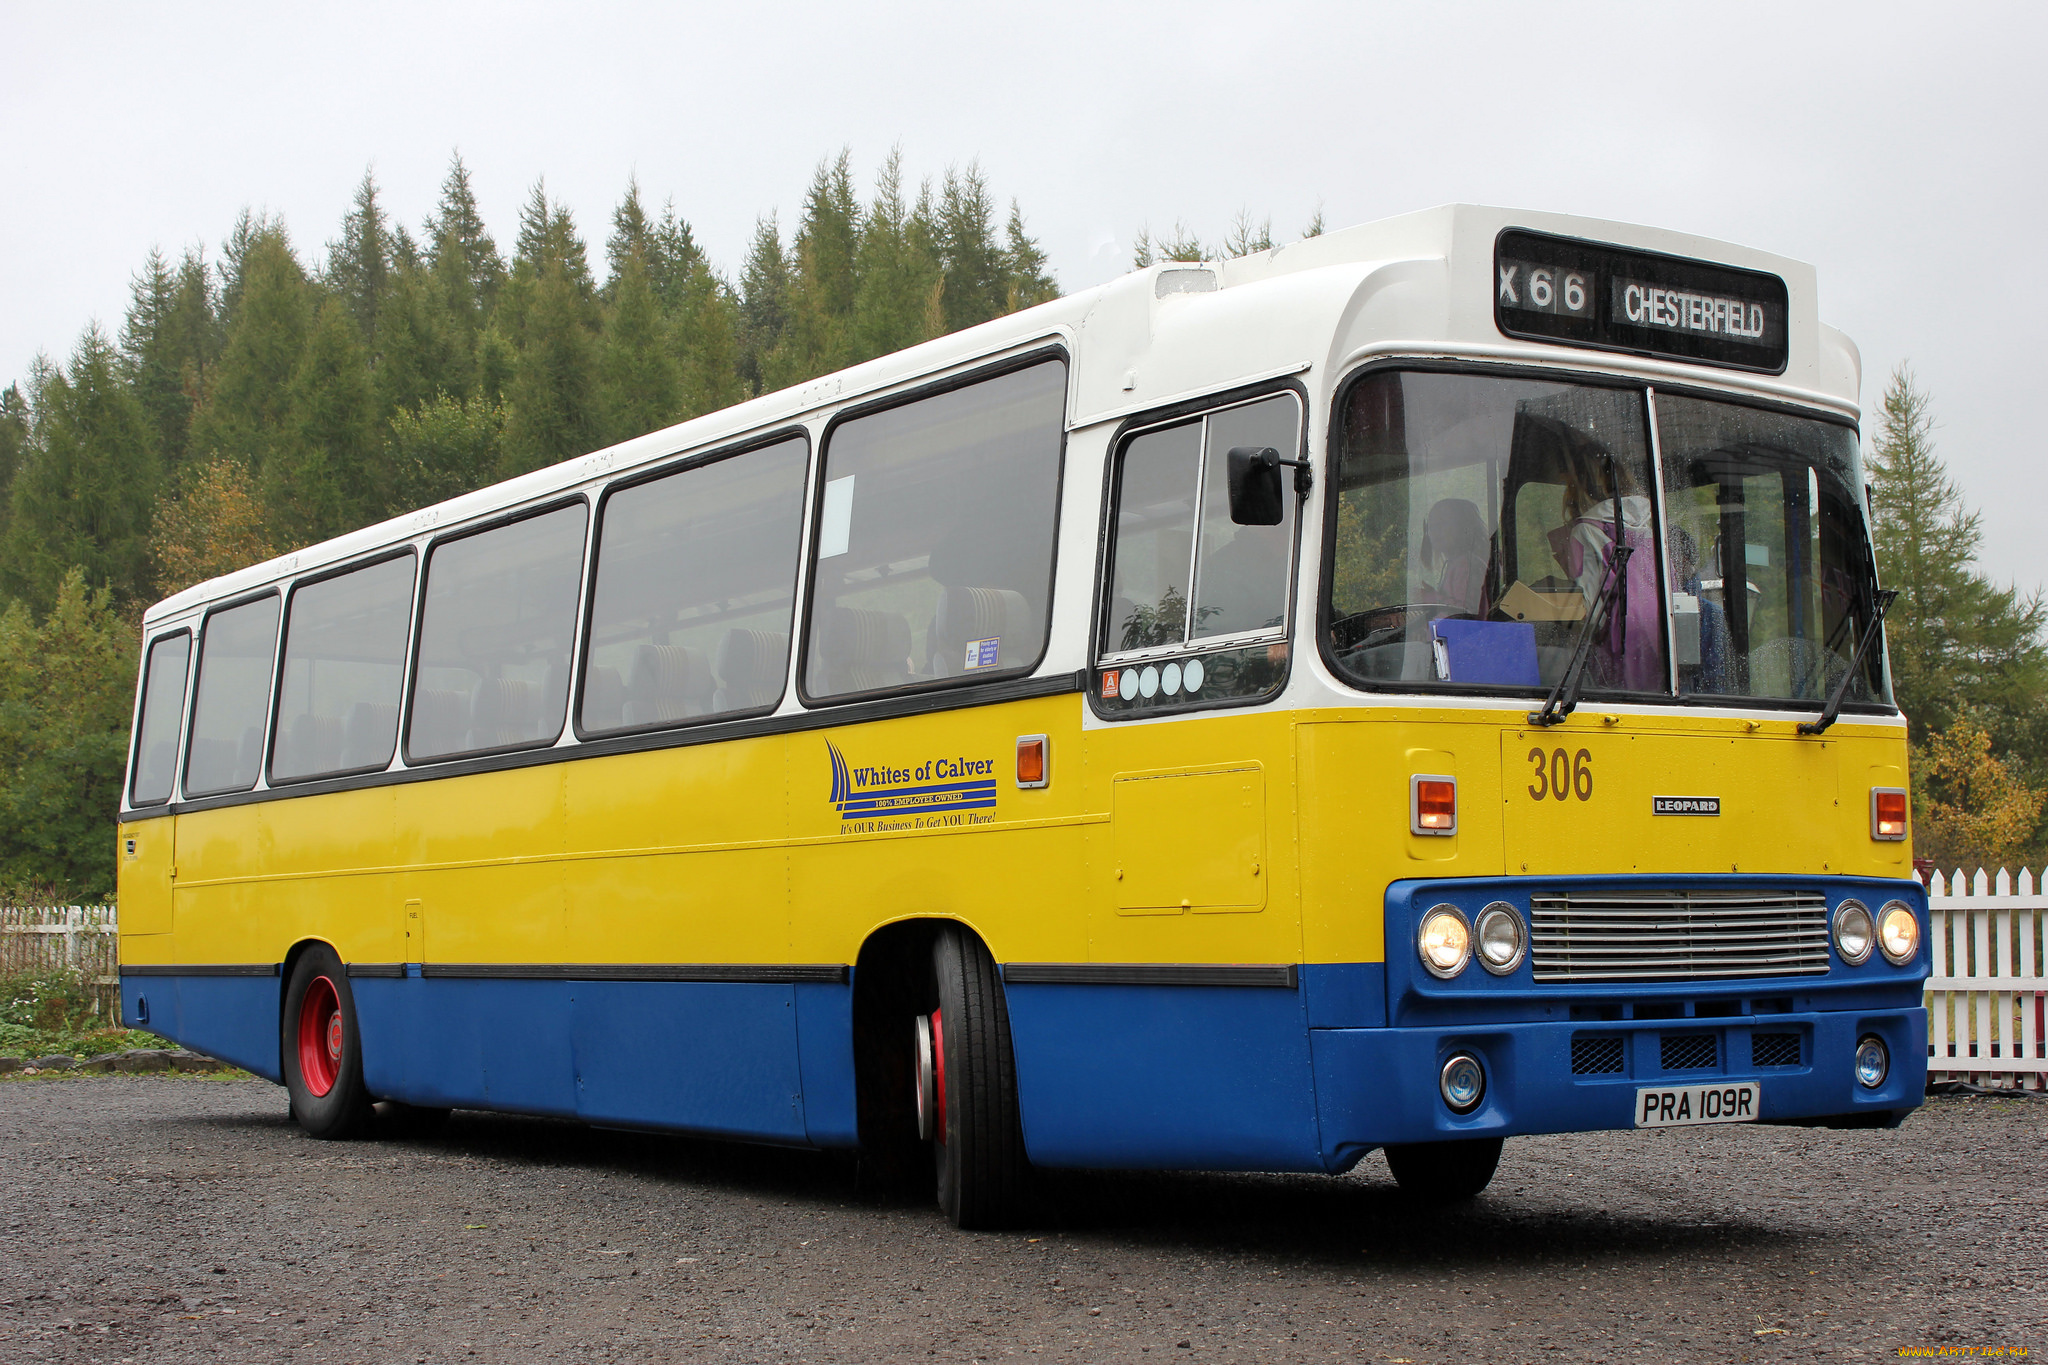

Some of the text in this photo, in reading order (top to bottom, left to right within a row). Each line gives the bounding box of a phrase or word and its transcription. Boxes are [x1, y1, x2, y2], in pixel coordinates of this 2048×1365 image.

[1625, 284, 1764, 338] CHESTERFIELD
[1106, 676, 1115, 687] A
[854, 757, 994, 787] Whites of Calver
[1527, 747, 1593, 801] 306
[875, 793, 963, 808] 100% EMPLOYEE OWNED
[1656, 800, 1718, 811] LEOPARD
[841, 812, 997, 835] It's OUR Business To Get YOU There!
[1643, 1088, 1752, 1122] PRA 109R
